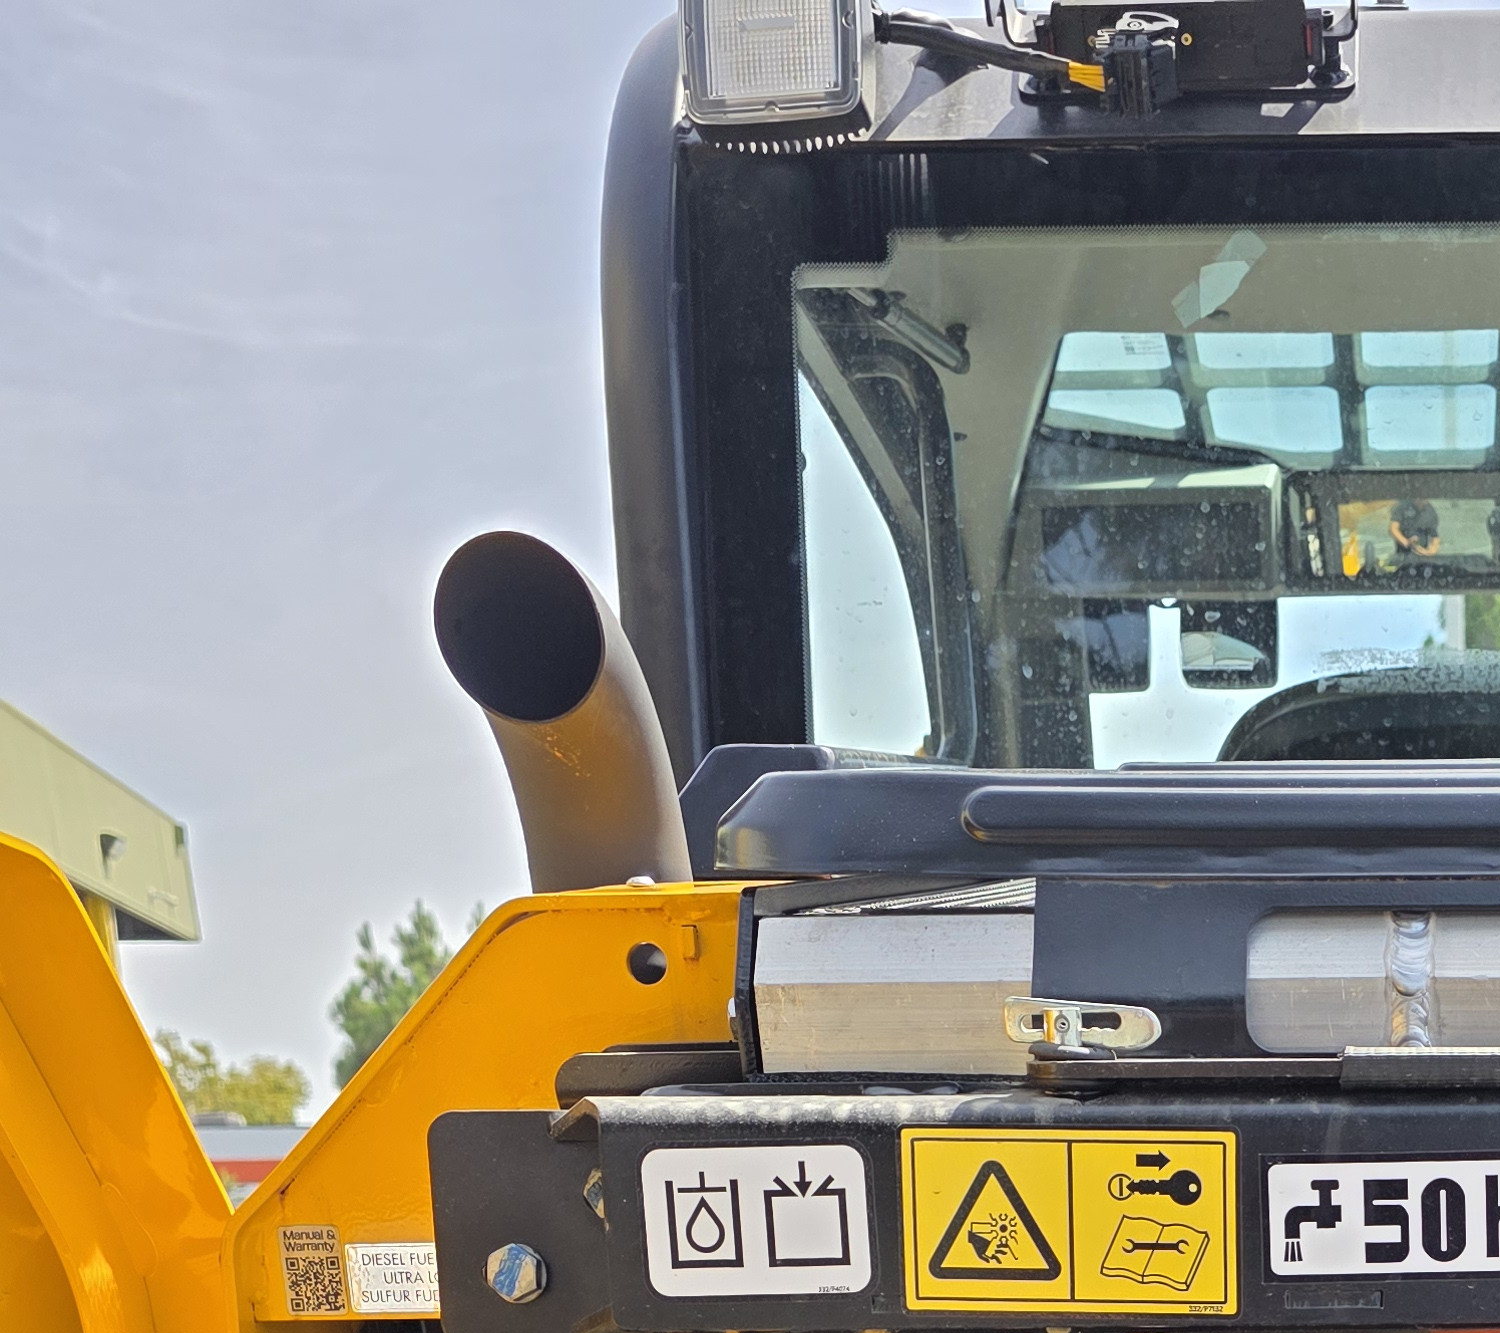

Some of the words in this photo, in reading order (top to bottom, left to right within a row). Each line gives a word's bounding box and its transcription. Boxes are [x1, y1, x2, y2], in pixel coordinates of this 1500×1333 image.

[1363, 1177, 1466, 1263] 50
[283, 1230, 324, 1241] Manual
[327, 1229, 336, 1240] &
[283, 1241, 336, 1253] Warranty
[361, 1253, 406, 1266] DIESEL
[410, 1252, 436, 1265] FUE
[384, 1271, 424, 1284] ULTRA
[361, 1290, 412, 1302] SULFUR
[416, 1289, 439, 1302] FUE
